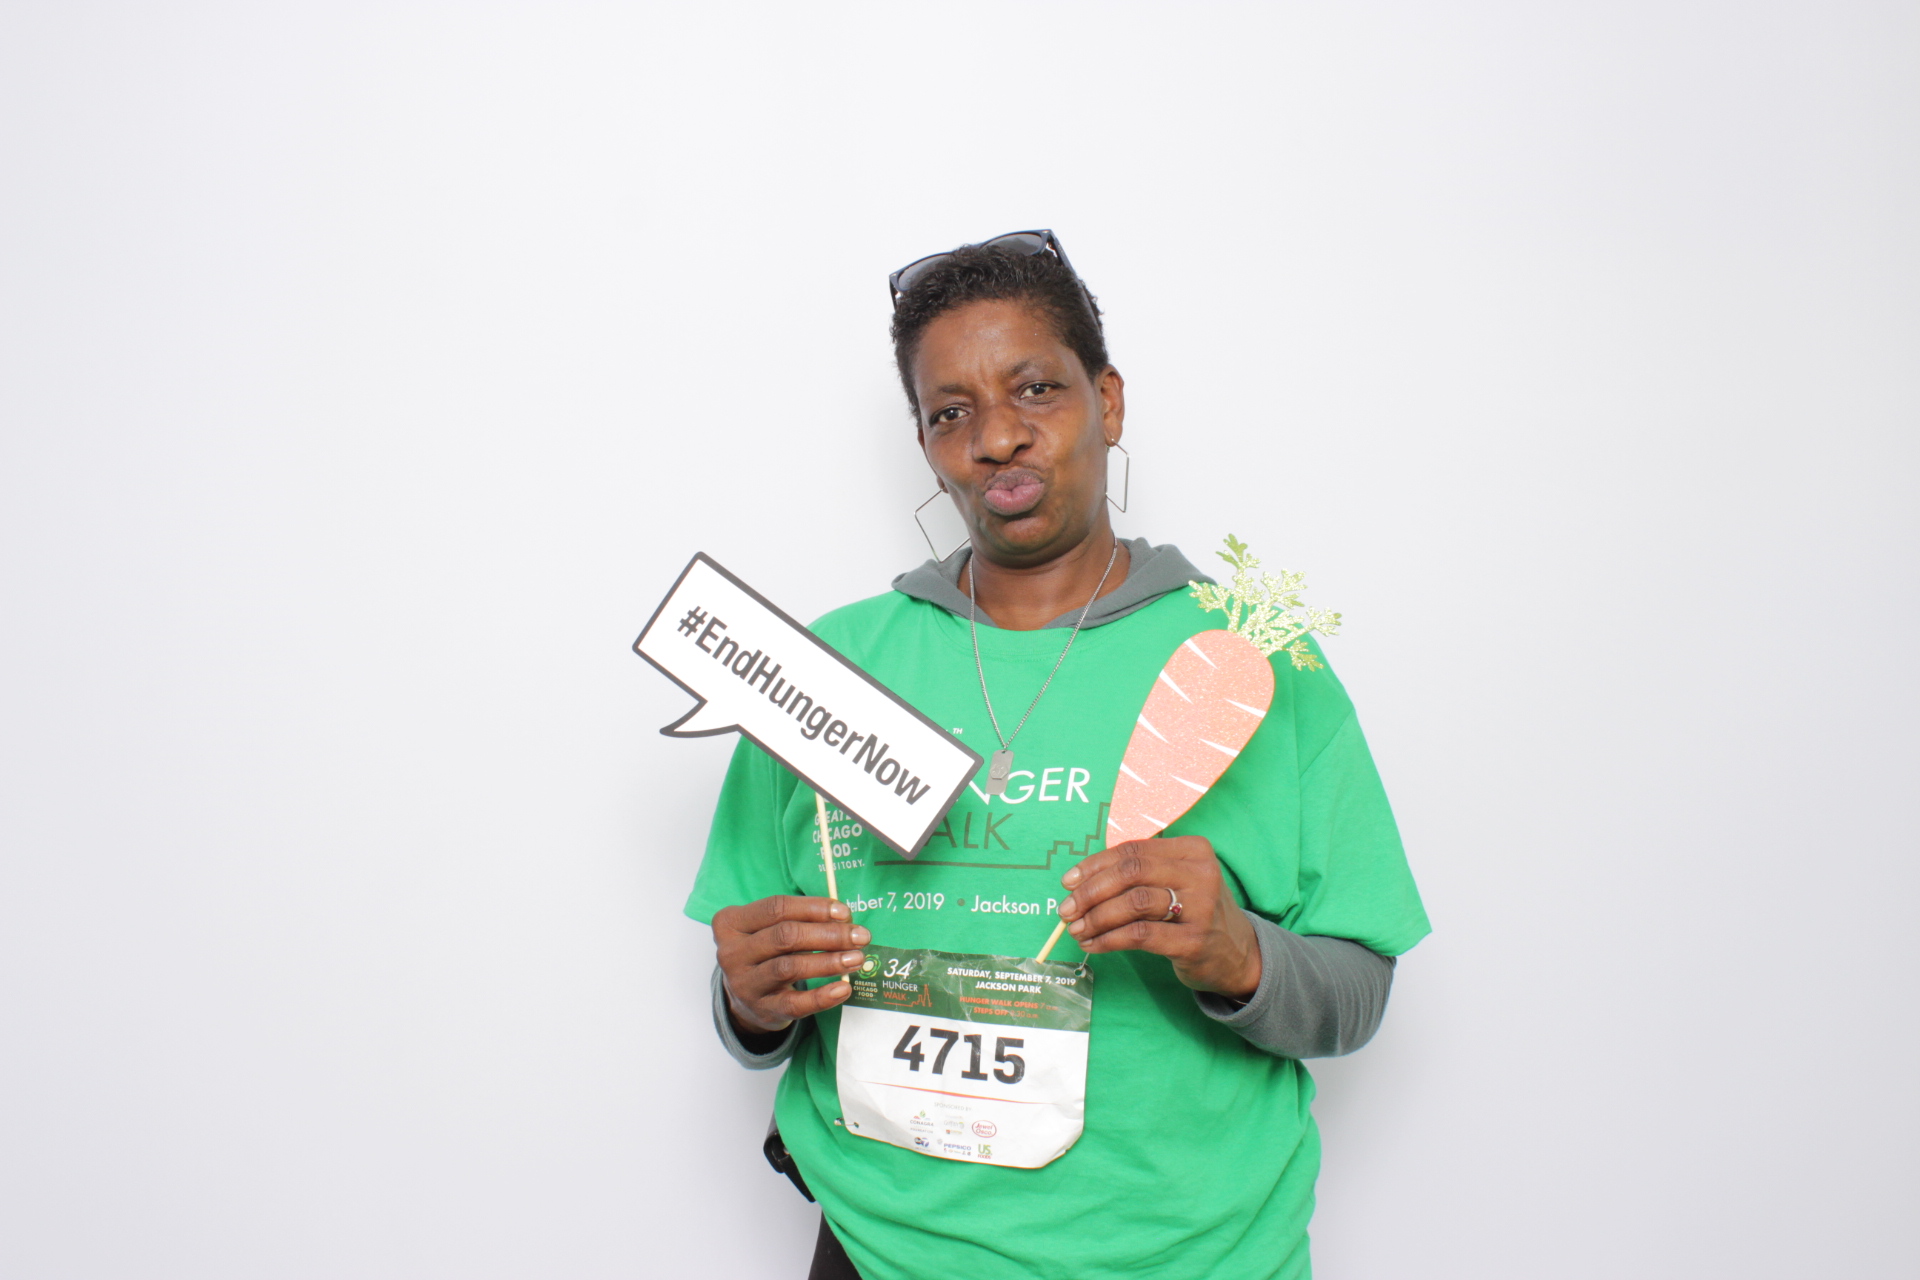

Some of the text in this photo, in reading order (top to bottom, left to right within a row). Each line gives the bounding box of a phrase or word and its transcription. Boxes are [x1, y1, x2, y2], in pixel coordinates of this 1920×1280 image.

[677, 605, 931, 806] #EndHungerNow
[925, 811, 1014, 850] ALK
[887, 892, 897, 912] 7,
[904, 892, 945, 910] 2019
[971, 895, 1040, 915] Jackson
[947, 967, 1077, 986] SATURDAY, SEPTEMBER 7, 2019
[853, 986, 879, 994] CHICAGO
[854, 980, 877, 988] GREATER
[882, 980, 918, 992] HUNGER
[975, 981, 1042, 994] JACKSON PARK
[883, 991, 907, 1001] WALK
[960, 996, 990, 1005] HUNGER
[991, 999, 1012, 1007] WALK
[1014, 1001, 1039, 1009] OPENS
[973, 1007, 993, 1015] STEPS
[893, 1025, 1025, 1084] 4715
[943, 1143, 972, 1151] PEPSICO
